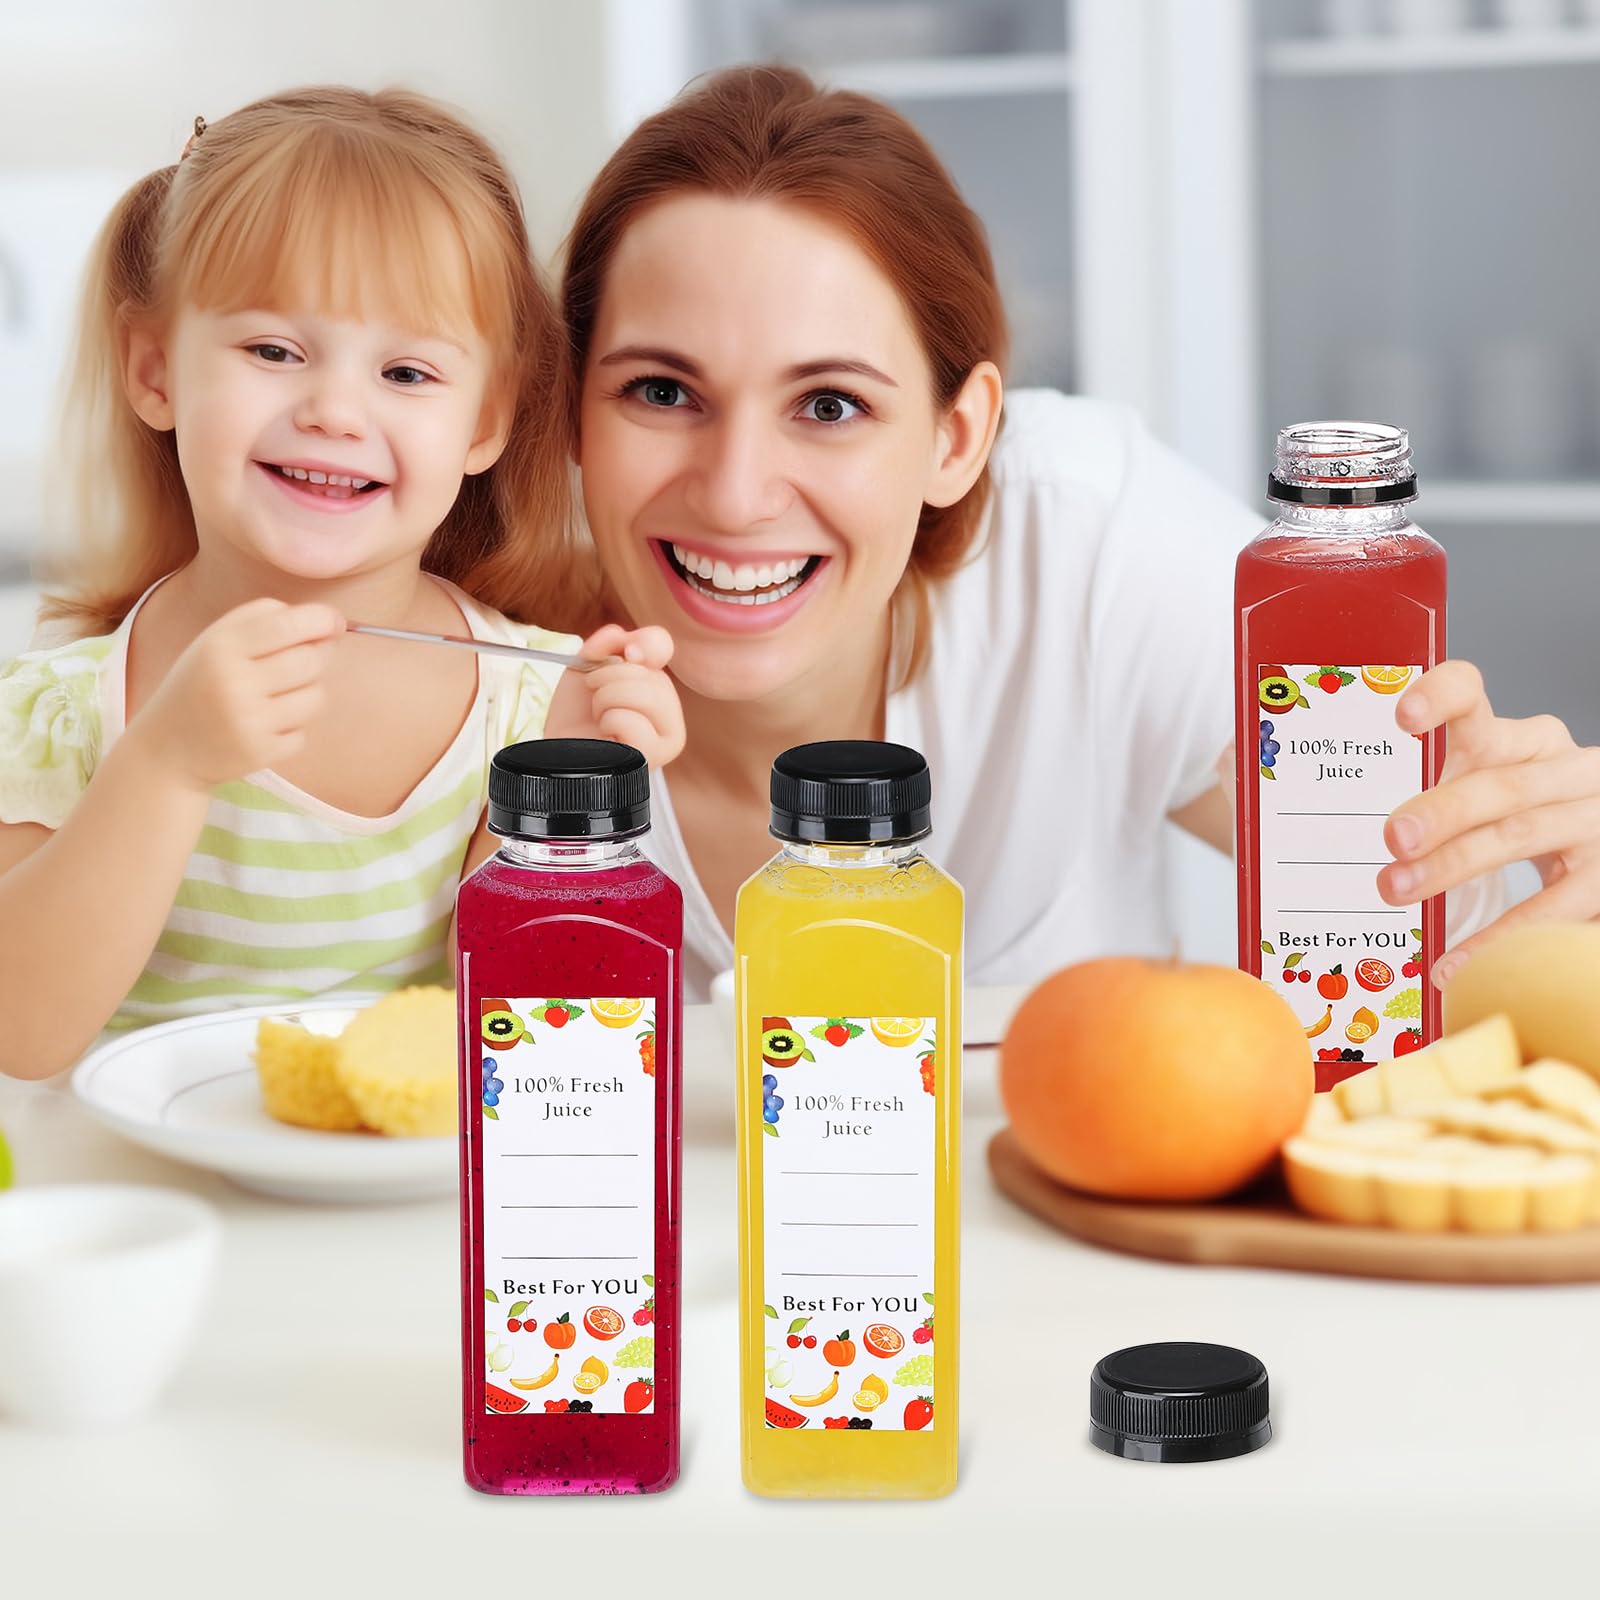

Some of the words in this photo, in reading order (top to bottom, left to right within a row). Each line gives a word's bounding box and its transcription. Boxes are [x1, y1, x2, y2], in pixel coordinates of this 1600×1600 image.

[1289, 738, 1337, 756] 100%
[1342, 739, 1394, 756] Fresh
[1315, 763, 1364, 782] Juice
[1278, 931, 1320, 948] Best
[1324, 932, 1358, 948] For
[1361, 932, 1407, 949] YOU
[514, 1075, 565, 1094] 100%
[570, 1076, 625, 1094] Fresh
[541, 1102, 593, 1121] Juice
[794, 1094, 845, 1112] 100%
[850, 1095, 904, 1112] Fresh
[821, 1120, 873, 1139] Juice
[502, 1279, 547, 1295] Best
[551, 1279, 586, 1295] For
[590, 1278, 638, 1295] YOU
[782, 1295, 827, 1312] Best
[831, 1296, 866, 1313] For
[870, 1296, 918, 1313] YOU
